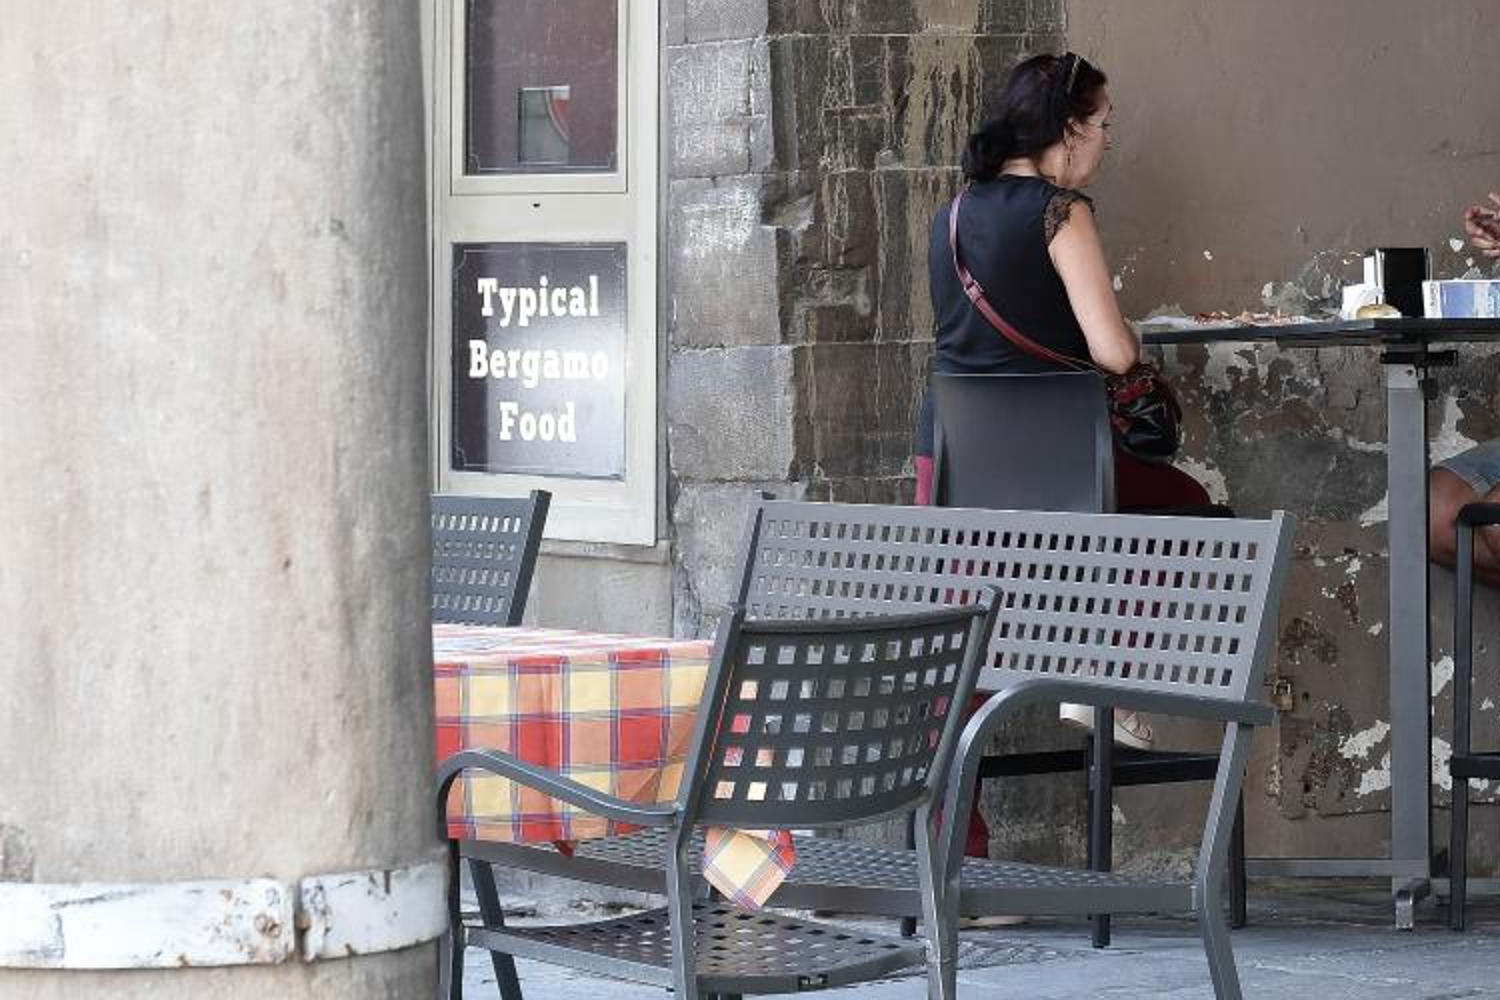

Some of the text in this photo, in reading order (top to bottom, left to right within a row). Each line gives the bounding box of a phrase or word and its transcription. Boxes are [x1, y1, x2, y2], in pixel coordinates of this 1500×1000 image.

[477, 275, 600, 327] Typical
[468, 339, 609, 389] Bergamo
[499, 401, 577, 442] Food
